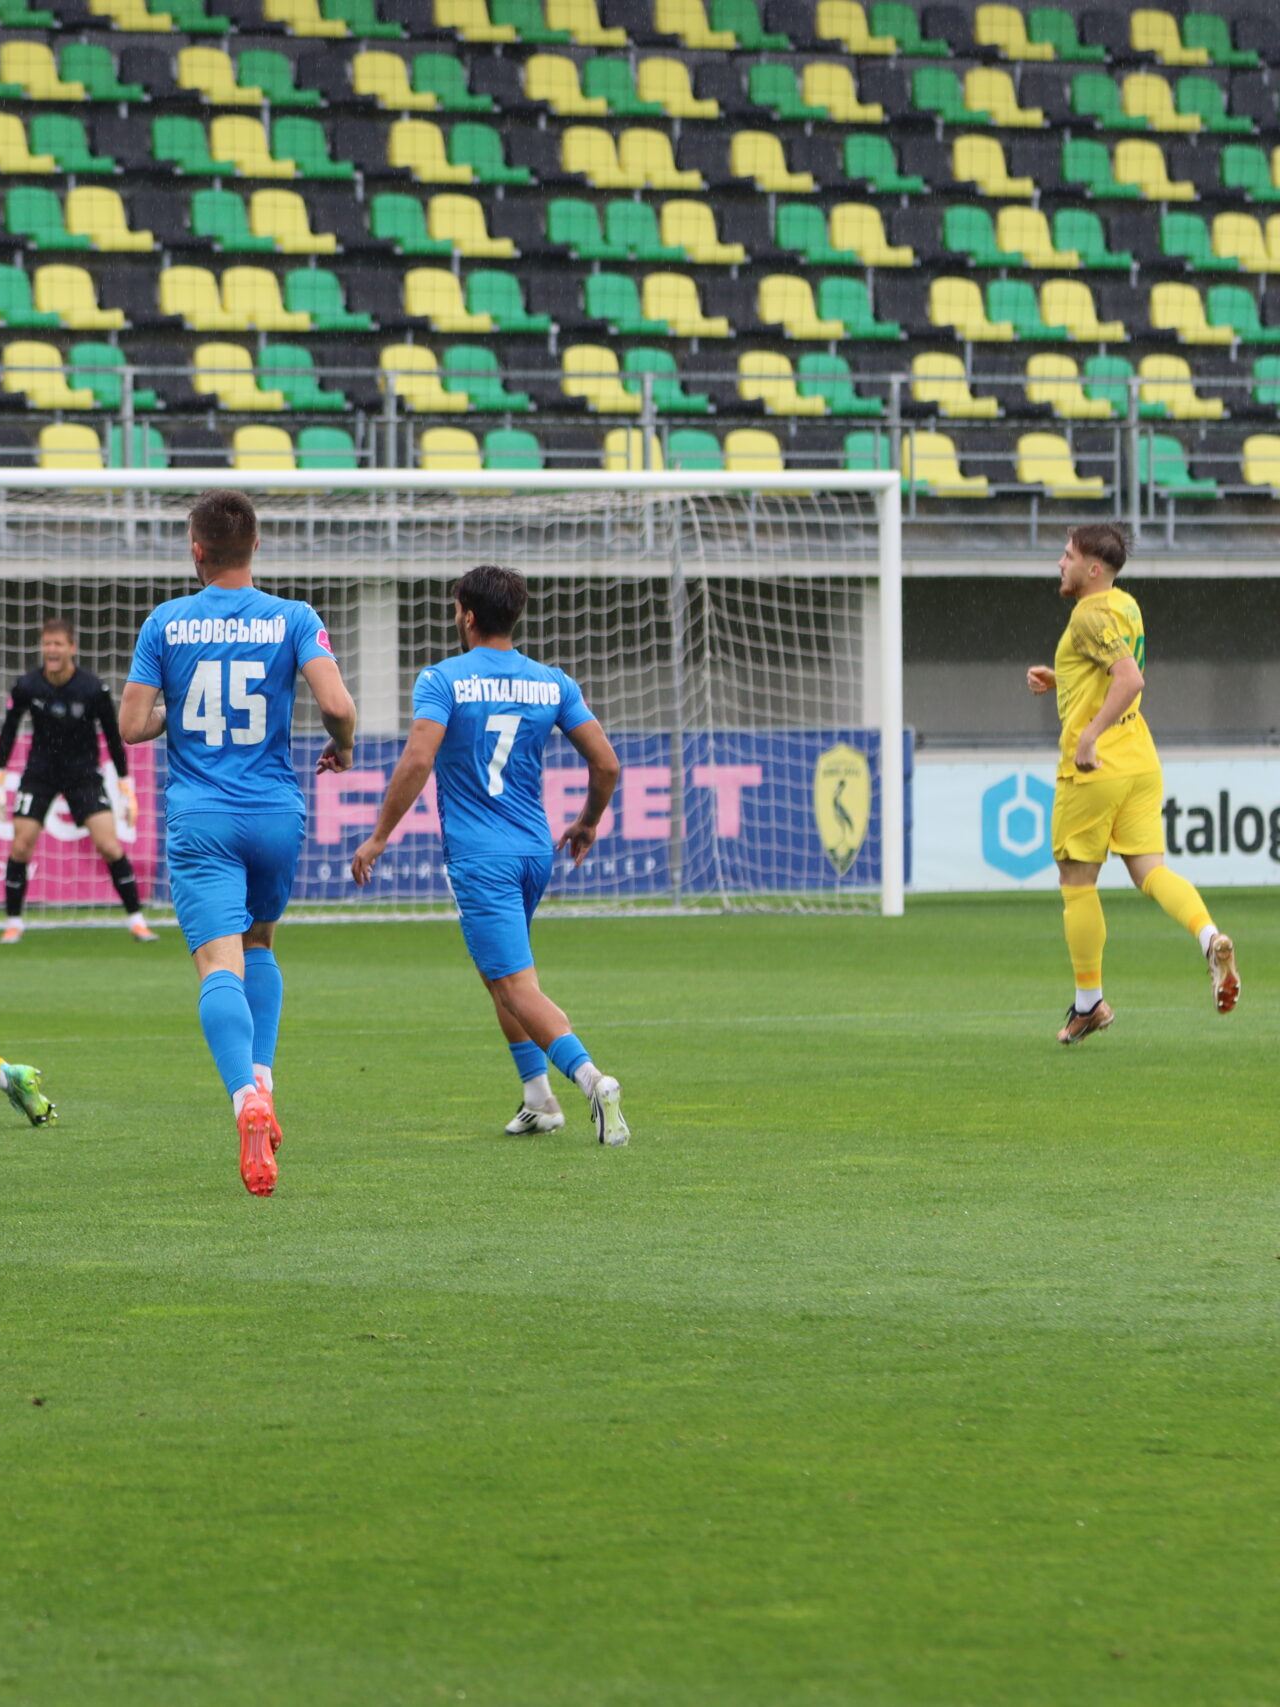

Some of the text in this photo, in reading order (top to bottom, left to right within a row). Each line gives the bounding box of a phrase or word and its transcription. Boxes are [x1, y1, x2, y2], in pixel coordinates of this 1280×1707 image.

[165, 615, 286, 646] САСОВСЬКИЙ
[182, 660, 267, 746] 45
[485, 715, 522, 797] 7
[316, 765, 762, 845] FABET
